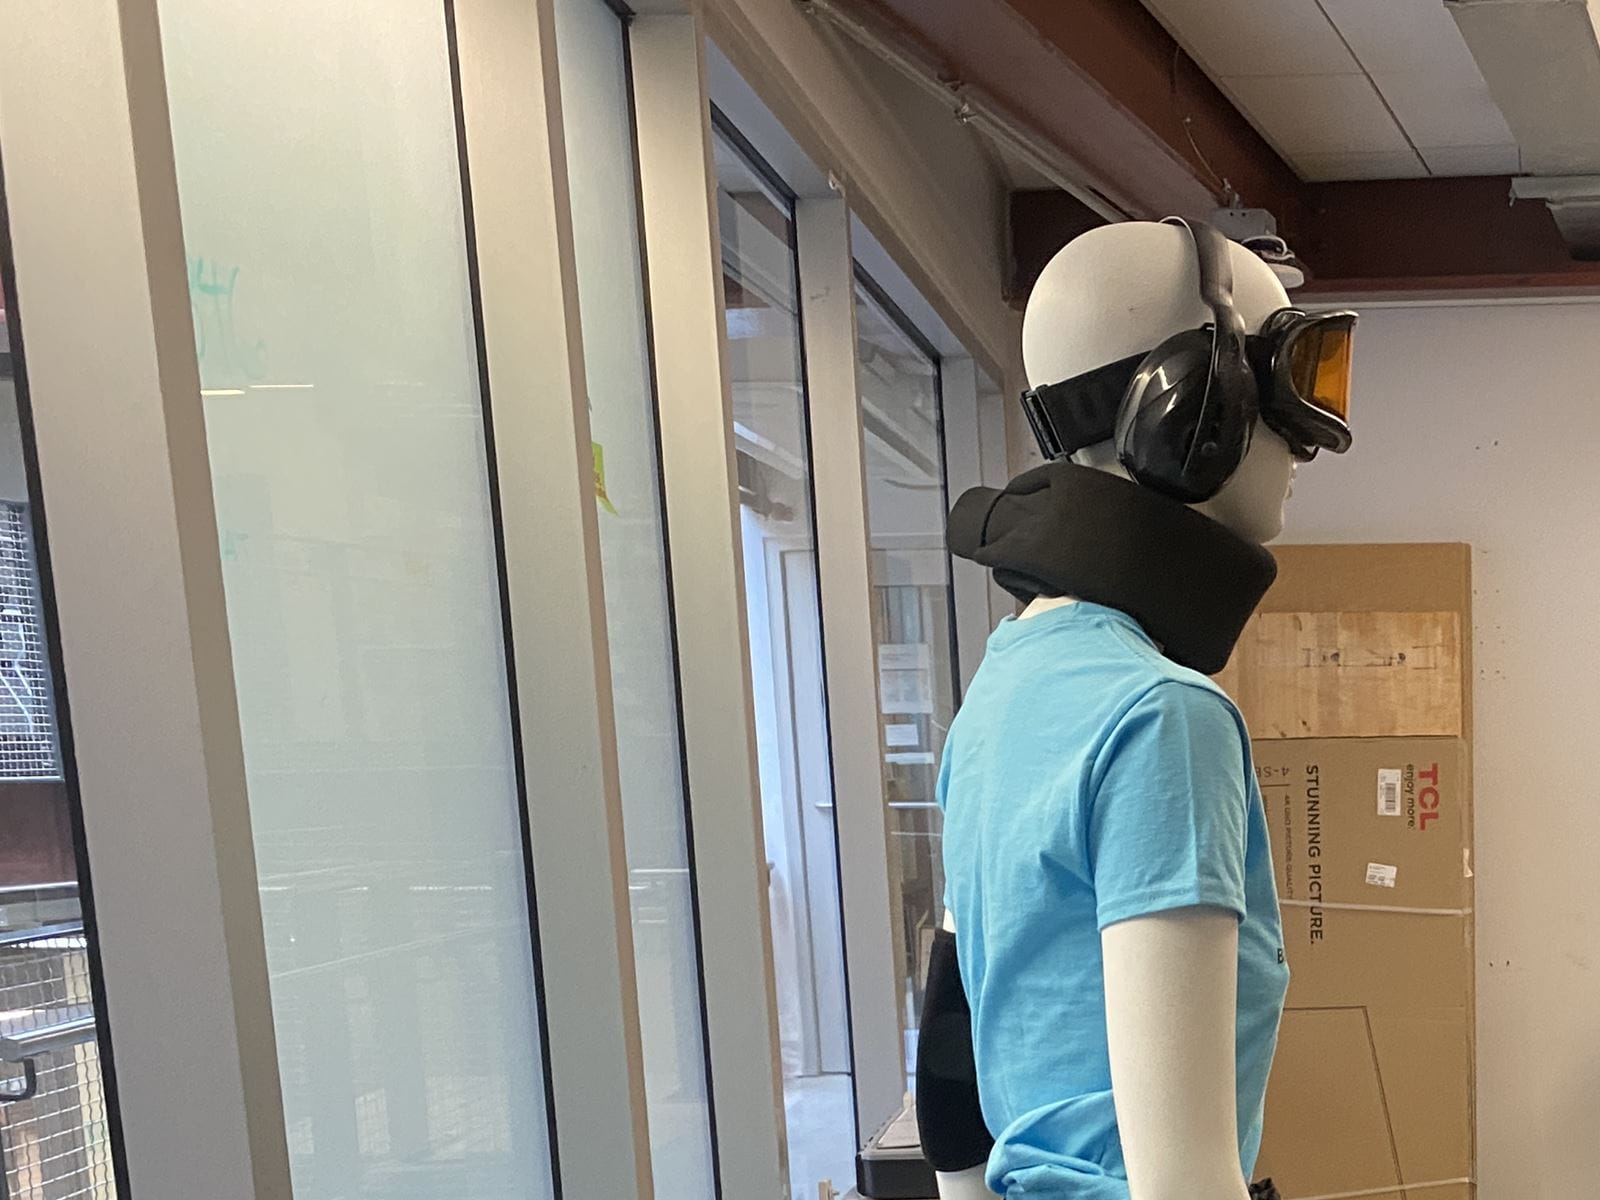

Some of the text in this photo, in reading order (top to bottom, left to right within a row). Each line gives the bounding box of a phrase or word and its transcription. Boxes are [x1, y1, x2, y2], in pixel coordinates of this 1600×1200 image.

[1404, 764, 1416, 795] enjoy
[1419, 763, 1440, 831] TCL
[1285, 827, 1293, 862] PICTURE
[1306, 765, 1323, 945] STUNNING PICTURE.
